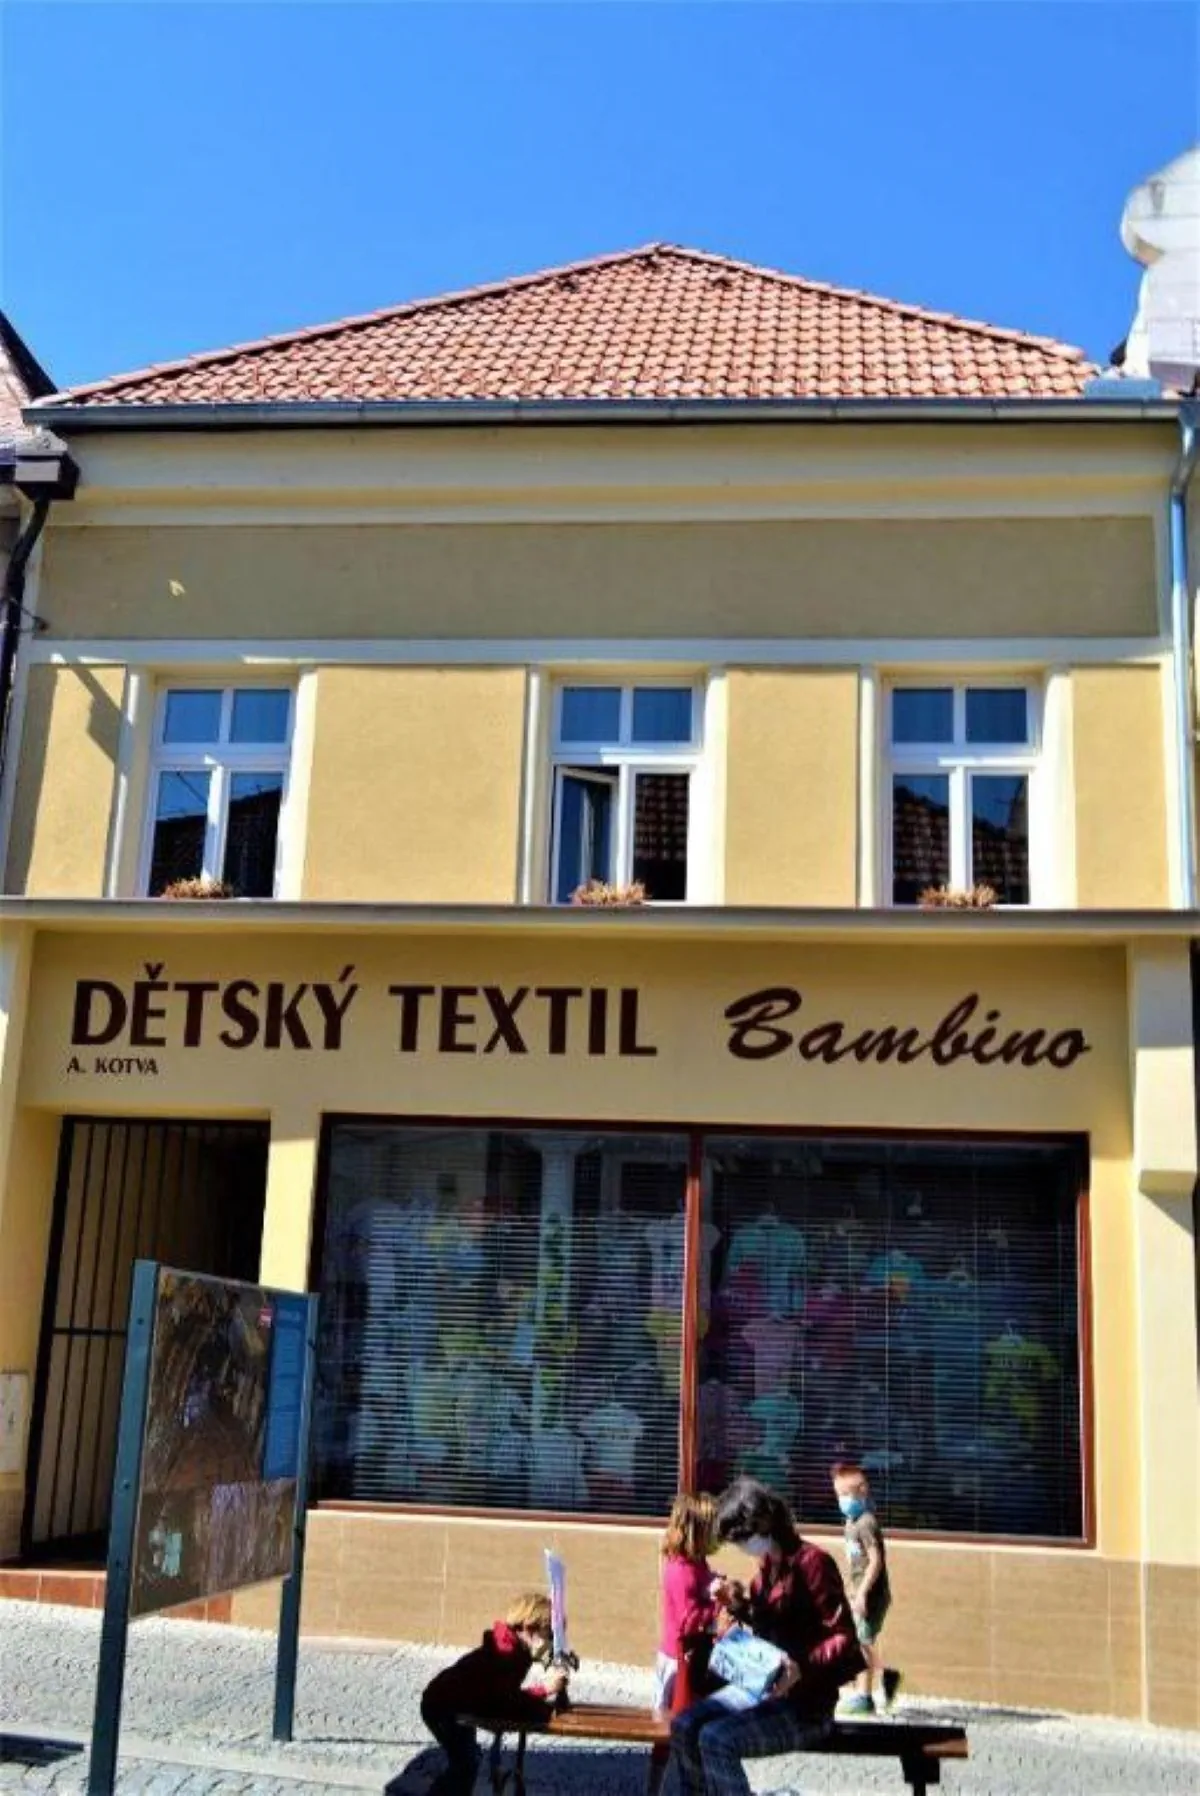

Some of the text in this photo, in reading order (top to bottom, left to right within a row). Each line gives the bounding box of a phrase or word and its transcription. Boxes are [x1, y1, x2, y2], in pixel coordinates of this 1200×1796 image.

[71, 962, 1092, 1069] DĚTSKÝ TEXTIL Bambino
[66, 1056, 159, 1075] A. KOTVA
